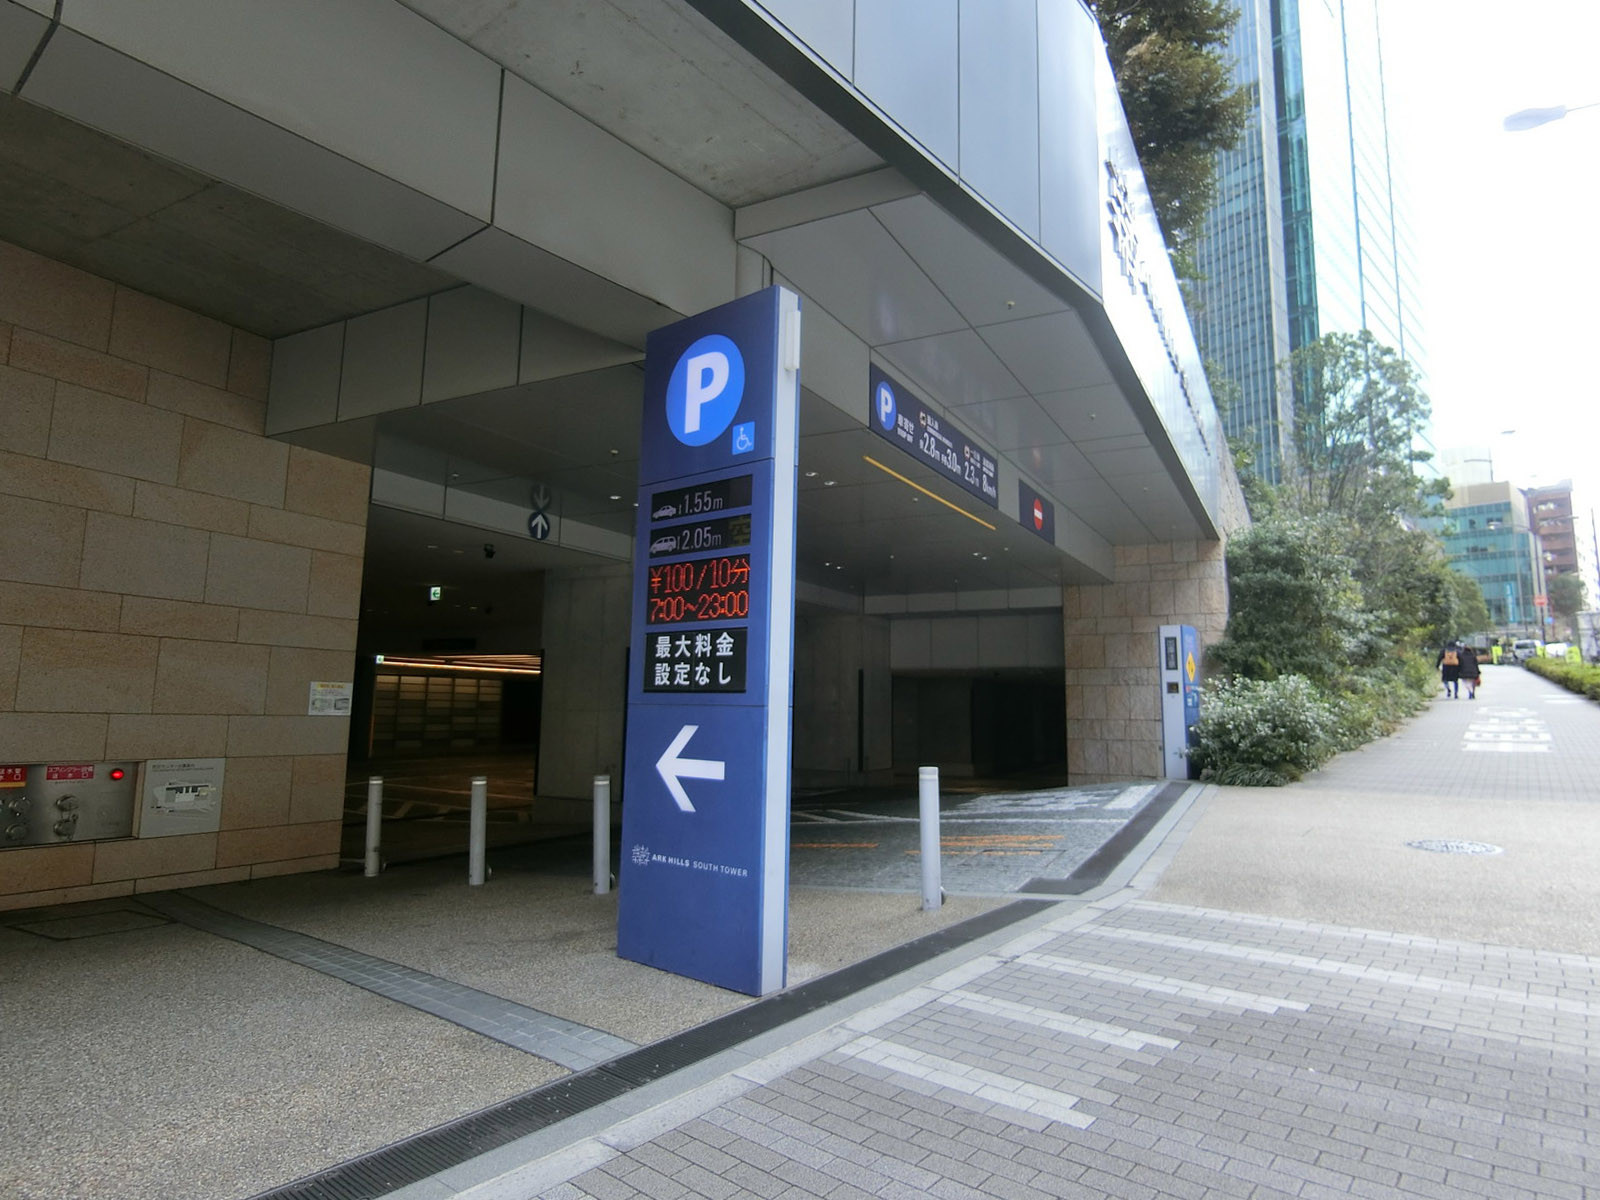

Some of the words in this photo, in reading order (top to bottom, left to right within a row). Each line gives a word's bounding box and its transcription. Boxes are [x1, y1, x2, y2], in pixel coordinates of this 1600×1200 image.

[684, 351, 730, 434] P
[880, 387, 893, 423] P
[655, 631, 735, 659] 最大料金
[654, 661, 732, 686] 設定なし
[651, 853, 668, 864] ARK
[668, 856, 690, 867] HILLS
[693, 860, 719, 873] SOUTH
[720, 864, 749, 878] TOWER
